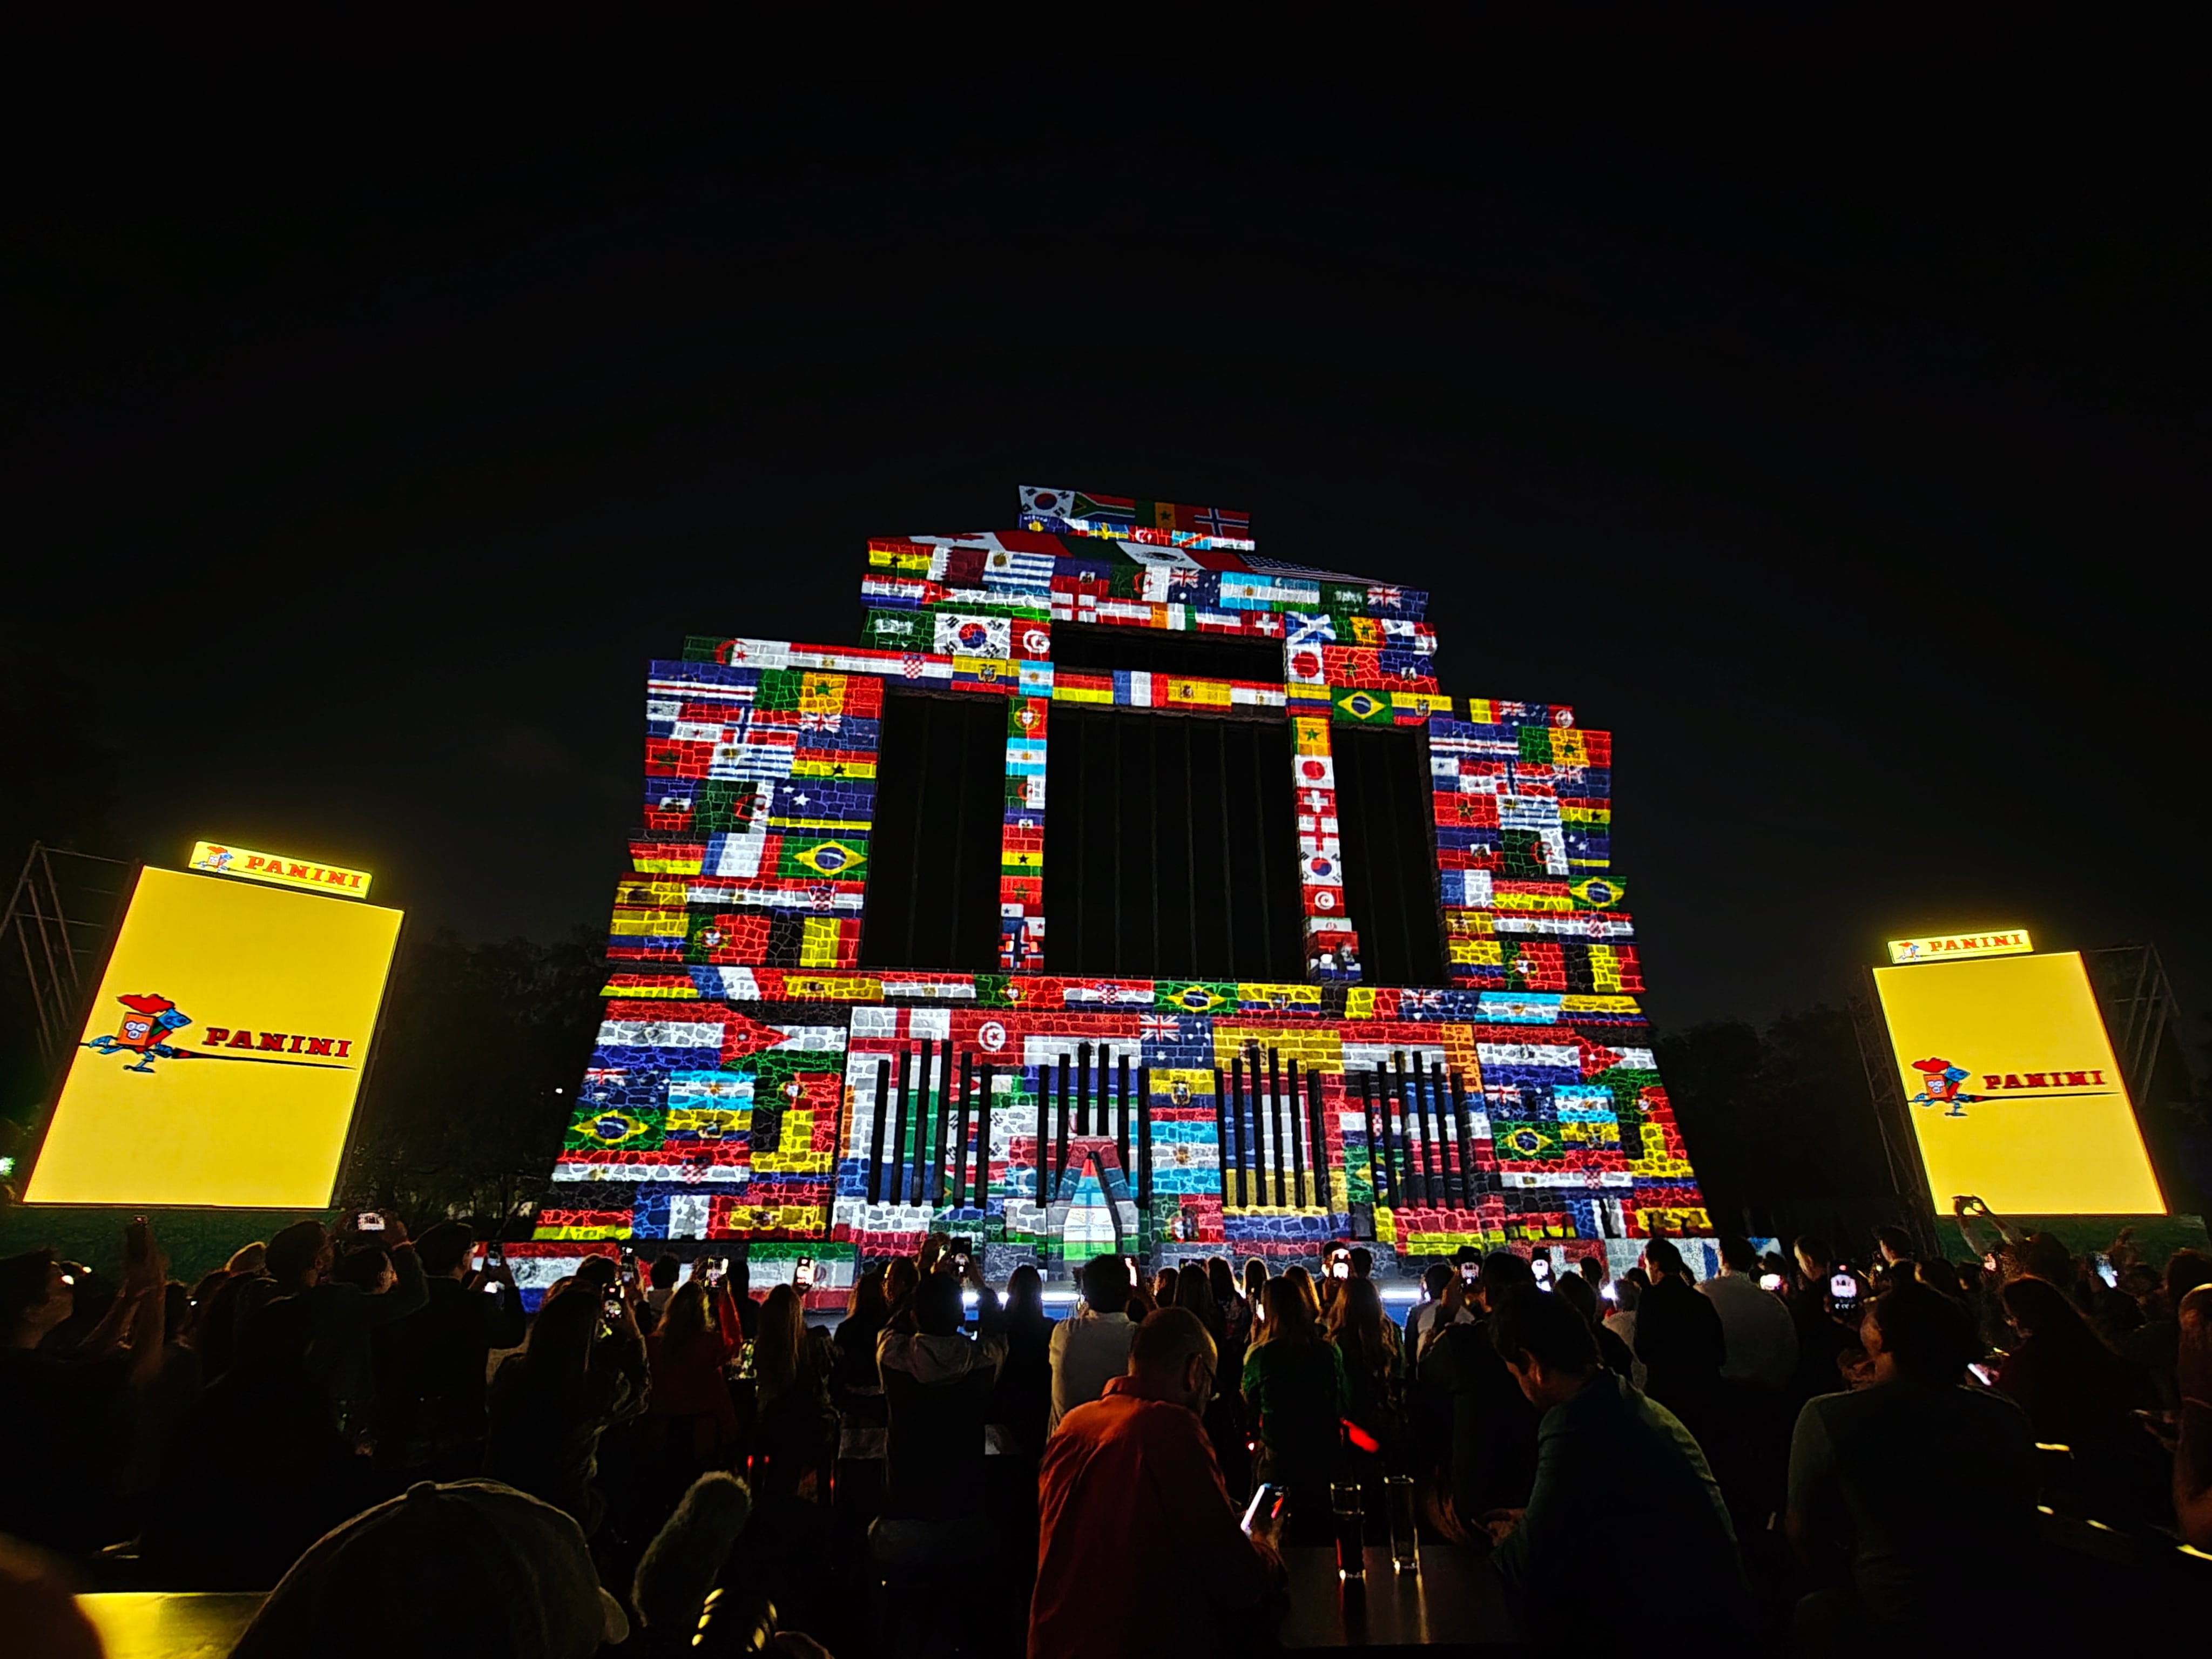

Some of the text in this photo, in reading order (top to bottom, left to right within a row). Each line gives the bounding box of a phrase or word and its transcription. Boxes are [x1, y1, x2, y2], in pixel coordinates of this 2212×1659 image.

[245, 855, 362, 888] PANINI
[1928, 934, 2022, 952] PANINI
[202, 1027, 353, 1058] PANINI
[1982, 1070, 2106, 1090] PANINI
